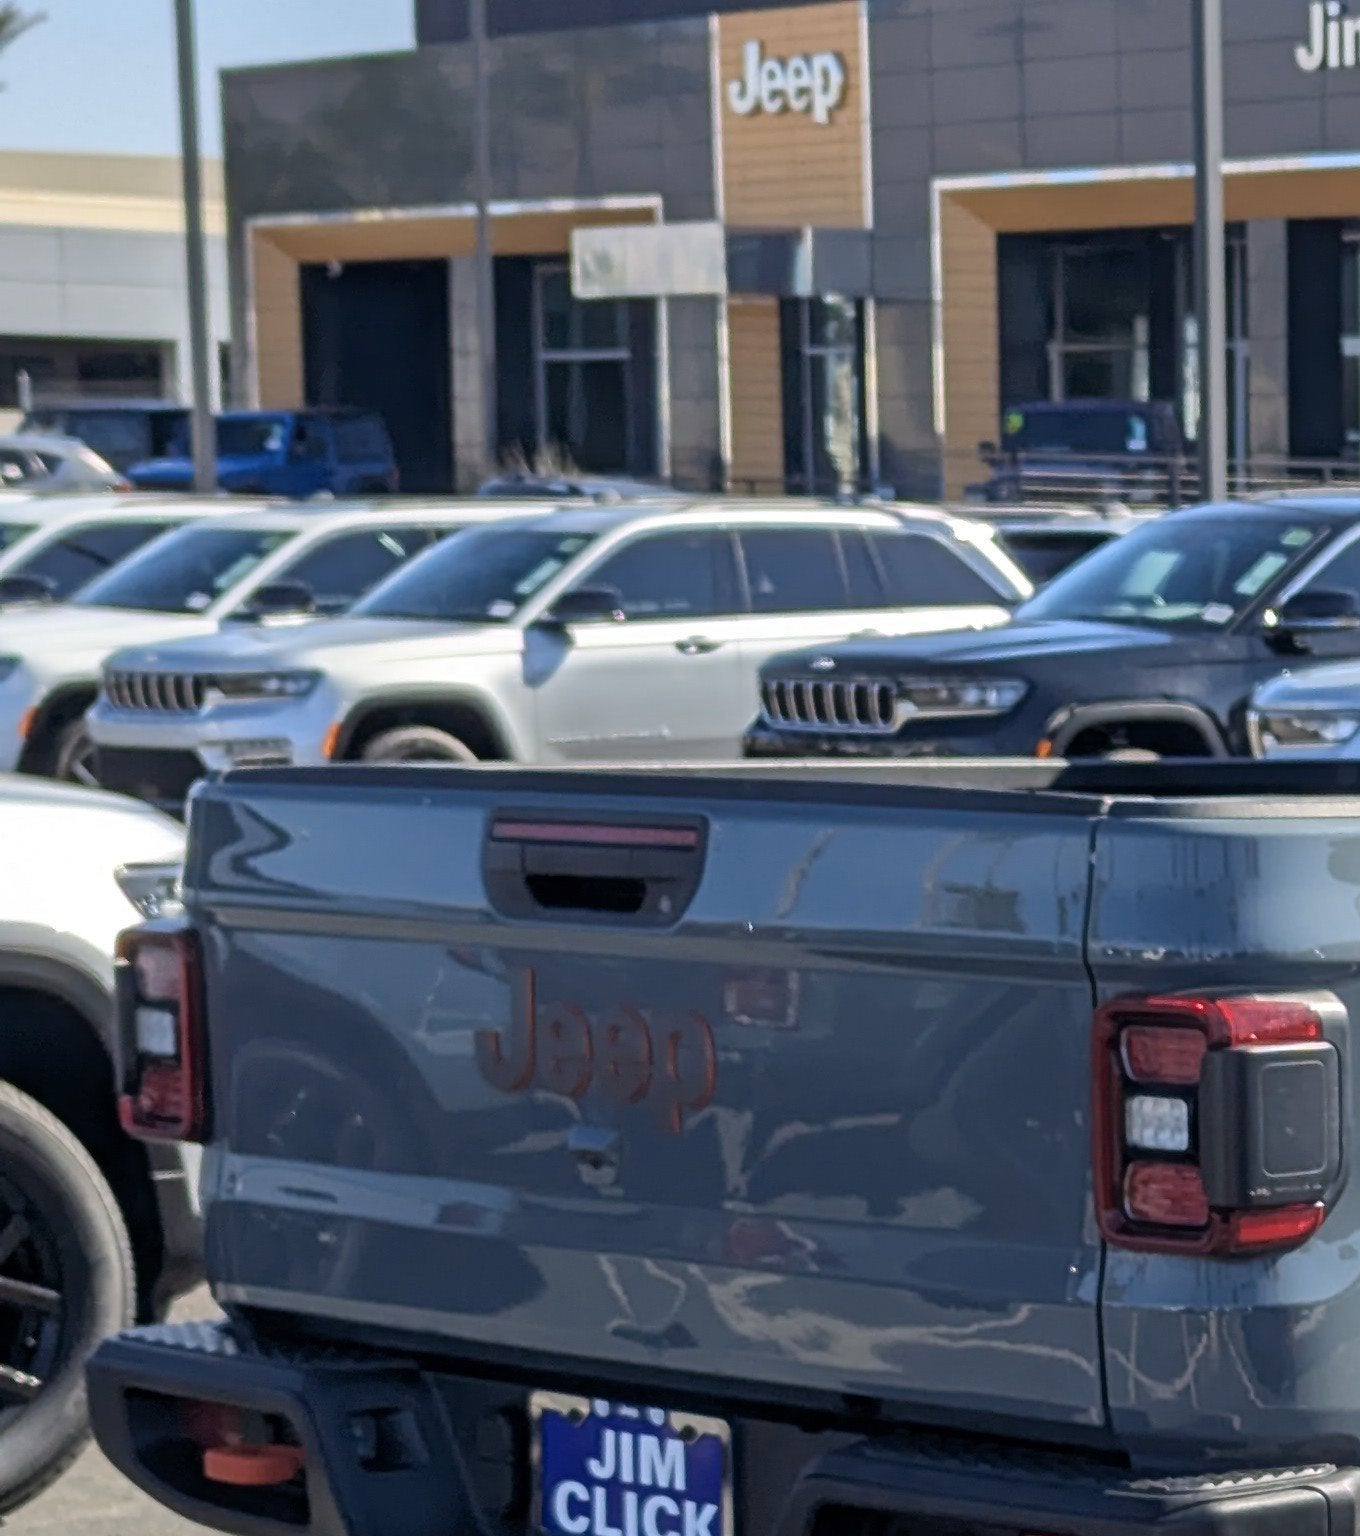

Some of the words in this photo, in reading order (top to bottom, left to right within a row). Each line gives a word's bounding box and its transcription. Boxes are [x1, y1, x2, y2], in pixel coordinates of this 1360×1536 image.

[728, 40, 847, 123] Jeep
[473, 967, 717, 1134] Jeep
[586, 1427, 687, 1491] JIM
